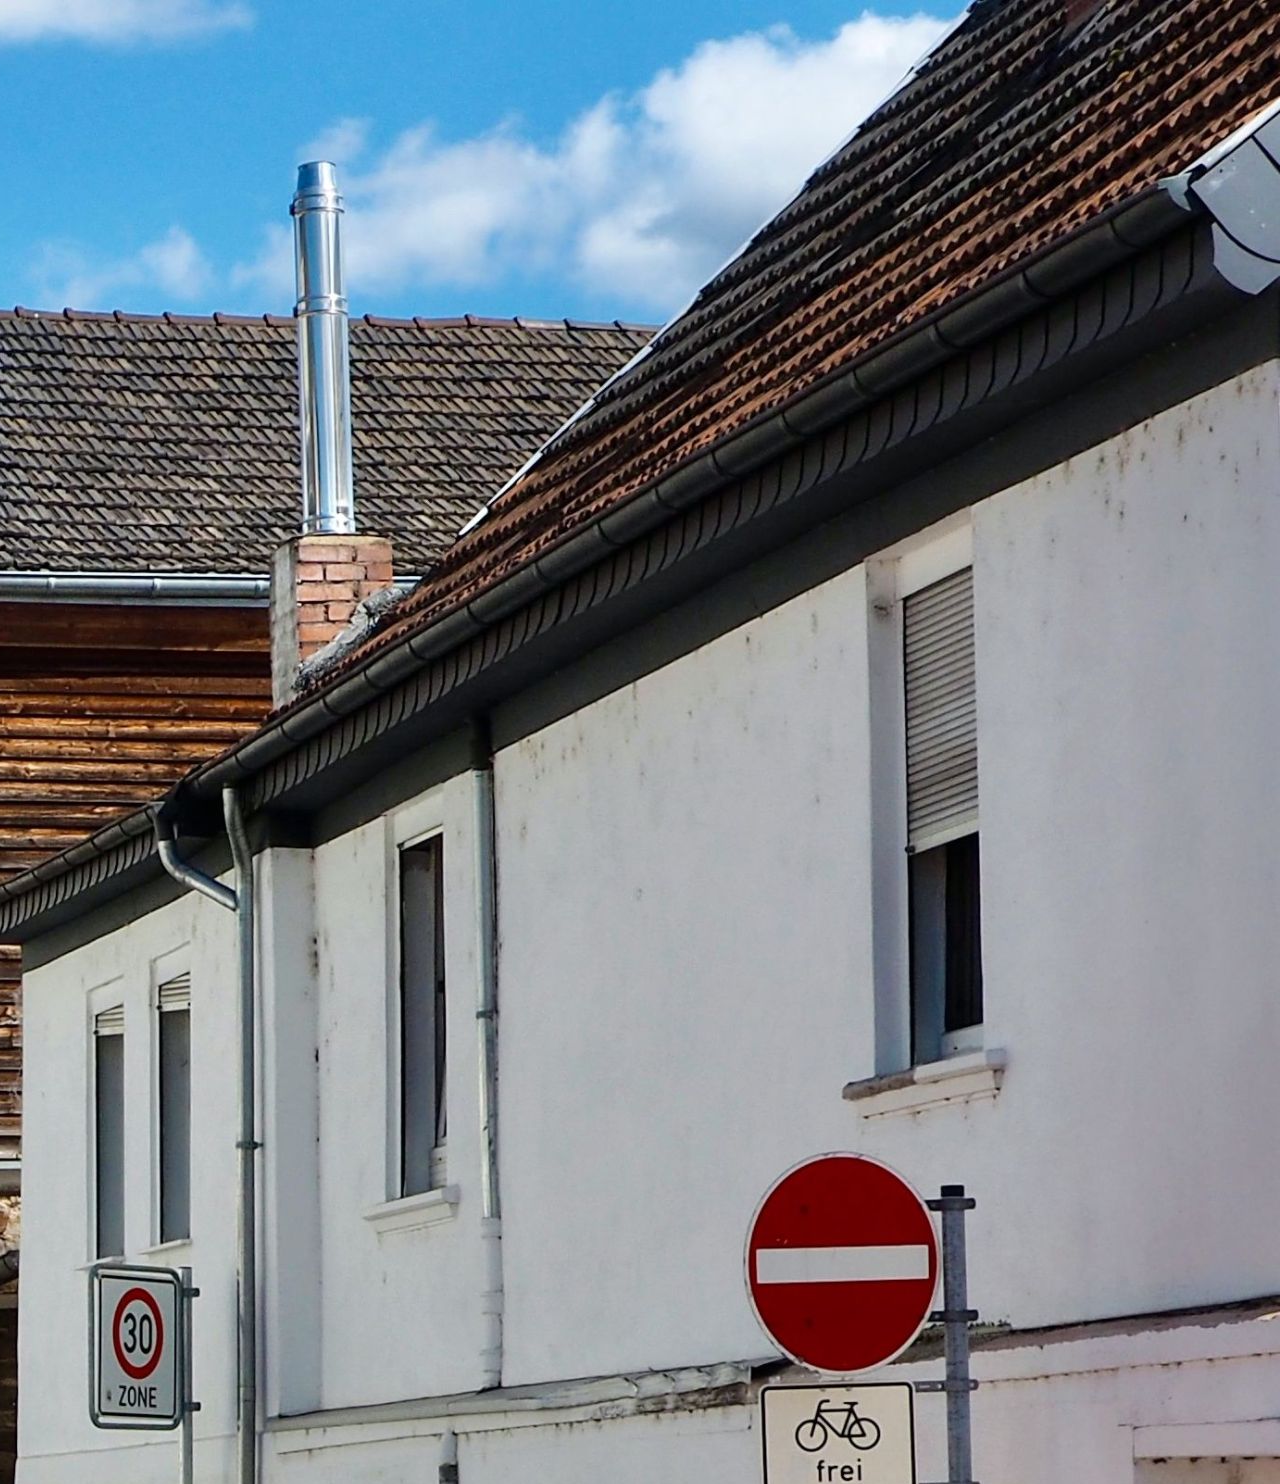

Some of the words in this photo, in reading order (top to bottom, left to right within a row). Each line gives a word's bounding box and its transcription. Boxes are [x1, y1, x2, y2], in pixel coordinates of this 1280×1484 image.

[123, 1312, 153, 1355] 30
[118, 1385, 157, 1408] ZONE
[816, 1457, 862, 1483] frei
